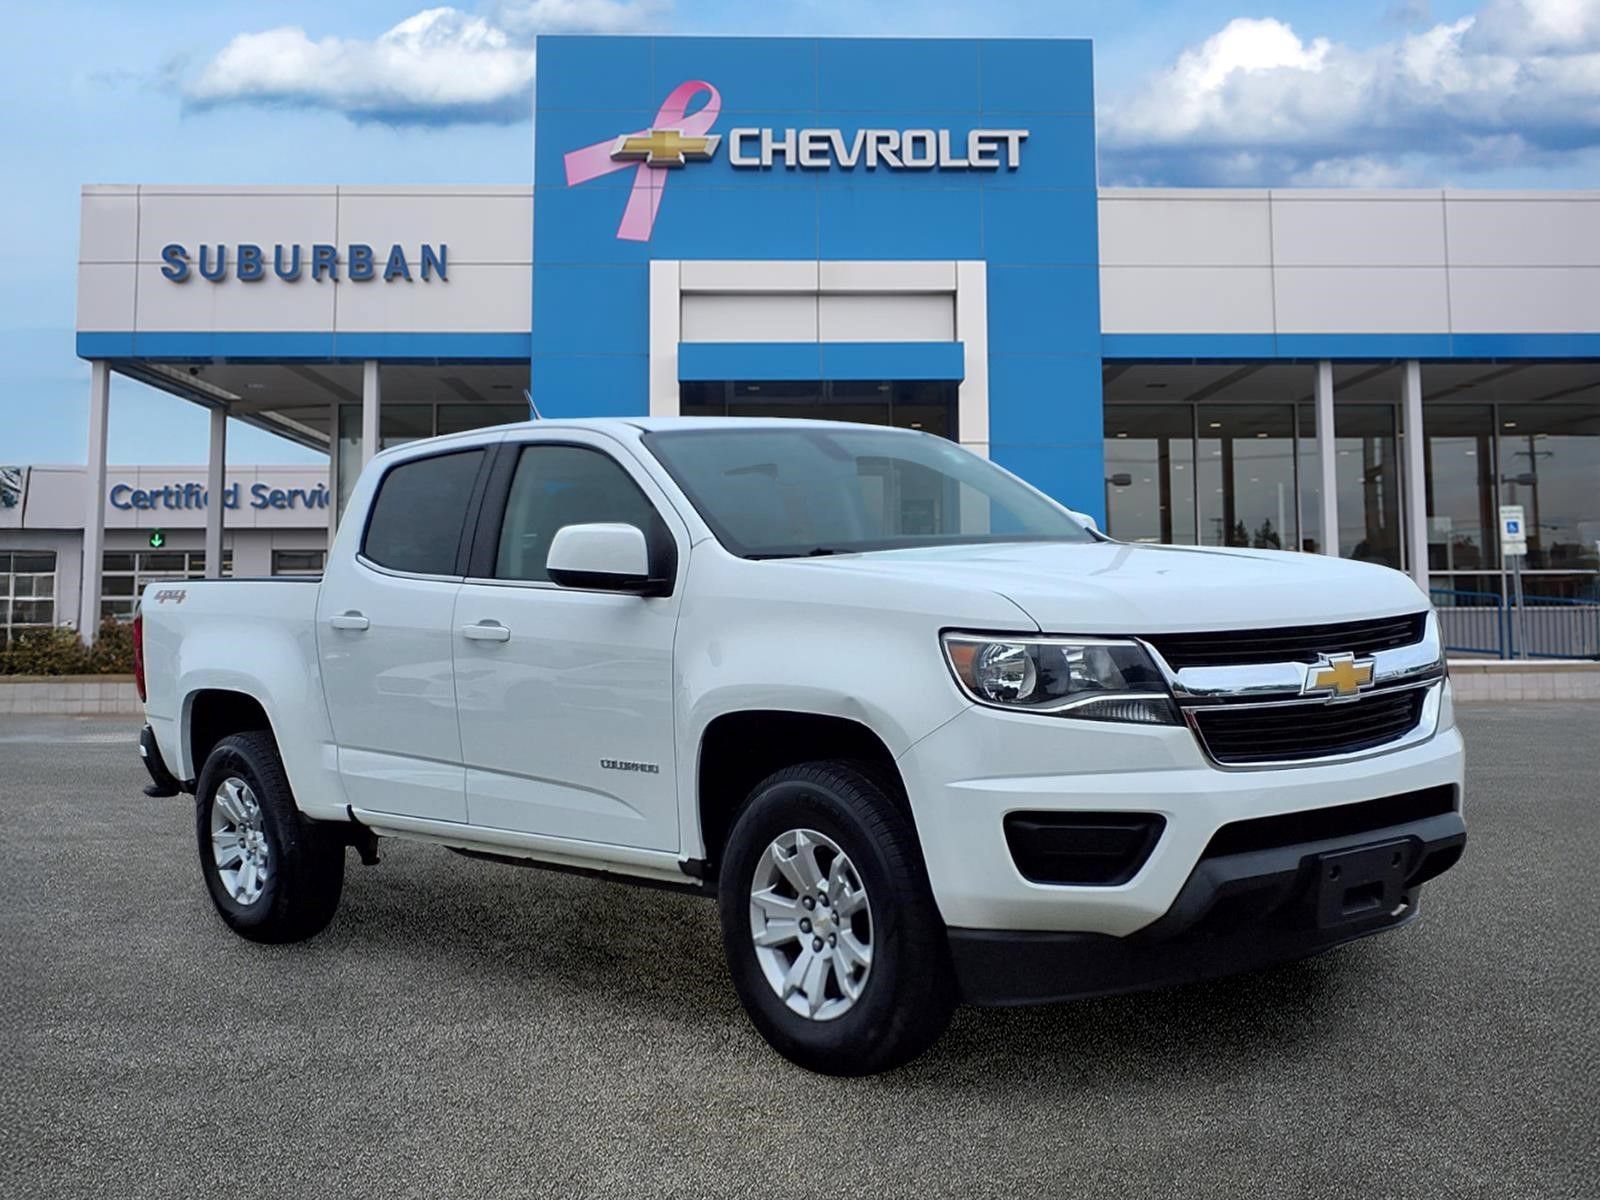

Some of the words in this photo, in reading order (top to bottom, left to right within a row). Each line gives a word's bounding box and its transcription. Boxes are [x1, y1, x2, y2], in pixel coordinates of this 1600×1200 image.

[729, 127, 1029, 169] CHEVROLET
[161, 243, 449, 283] SUBURBAN
[600, 759, 659, 774] COLORADO
